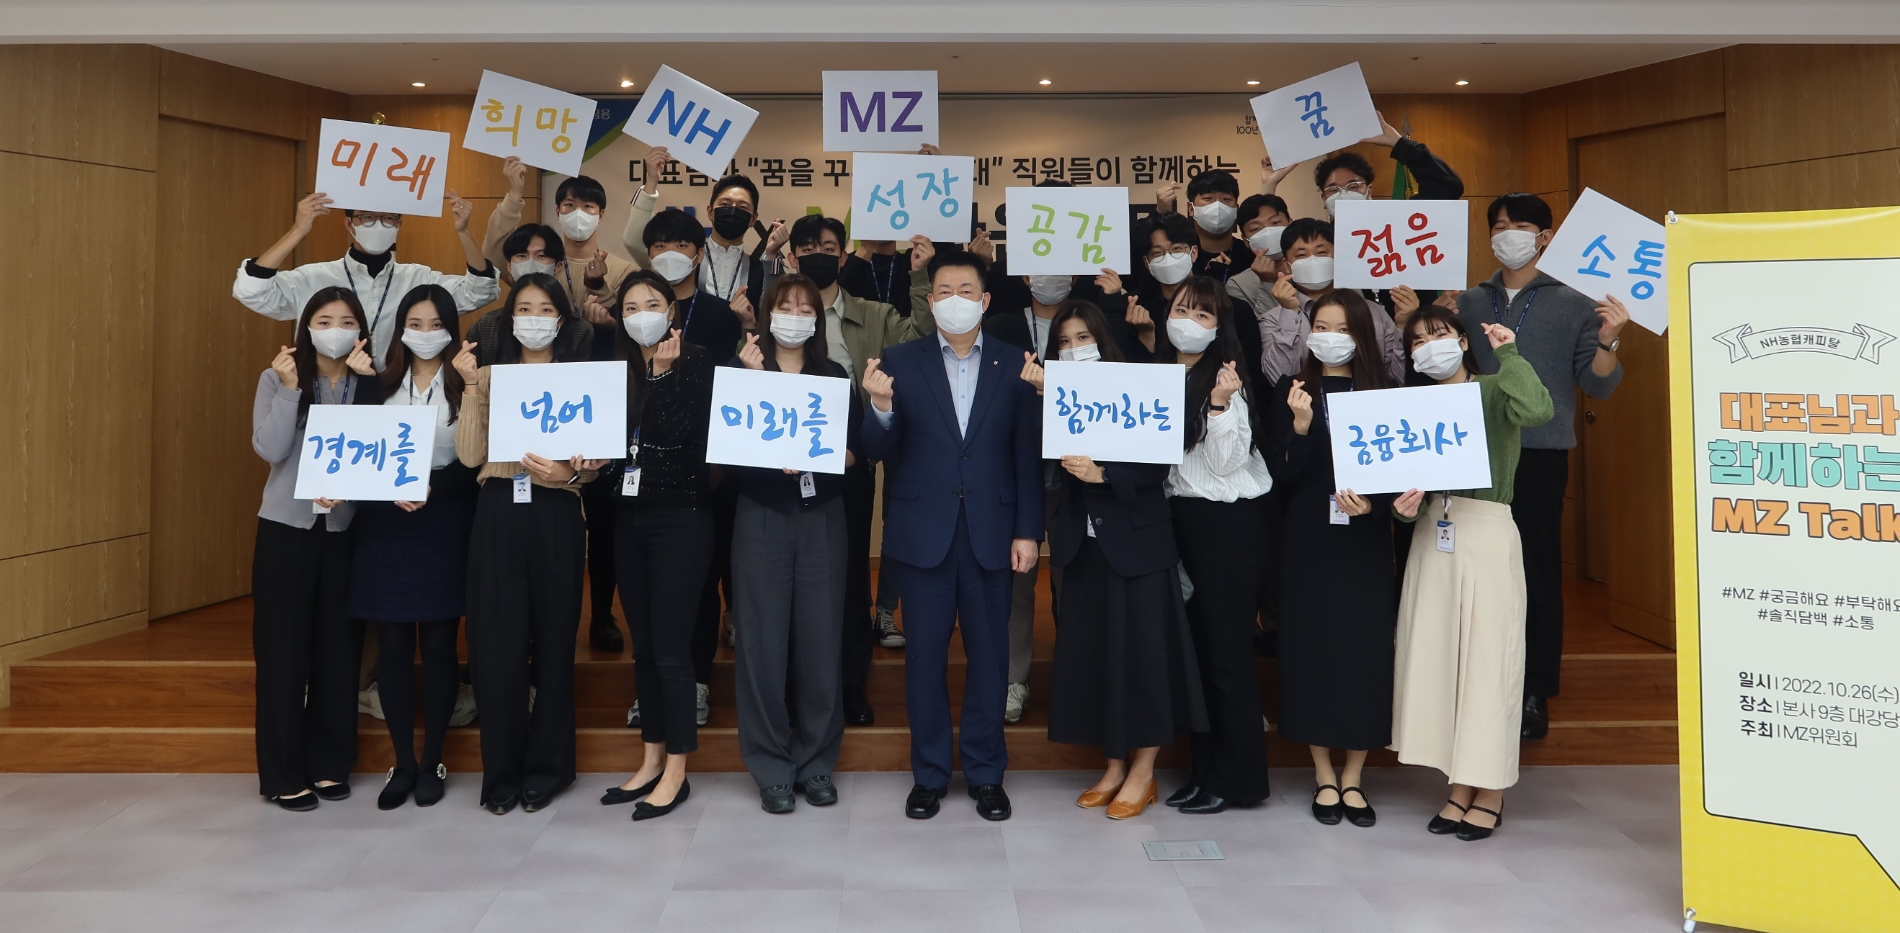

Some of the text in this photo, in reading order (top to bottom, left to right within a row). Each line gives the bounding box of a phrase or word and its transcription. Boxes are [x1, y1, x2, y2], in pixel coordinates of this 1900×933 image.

[480, 98, 577, 154] 희망
[647, 88, 732, 156] NH
[840, 91, 923, 132] MZ
[1294, 91, 1335, 139] 꿈
[331, 137, 435, 200] 미래
[1012, 156, 1121, 187] 직원들이
[867, 167, 959, 230] 성장
[1027, 204, 1112, 264] 공감
[1351, 212, 1445, 278] 젊음
[1577, 234, 1665, 300] 소통
[1760, 333, 1841, 349] NH농협캐피탈
[520, 391, 593, 434] 넘어
[721, 392, 834, 459] 미래를
[1055, 386, 1172, 435] 함께하는
[1719, 392, 1900, 436] 대표님과
[308, 422, 419, 487] 경계를
[1348, 418, 1468, 466] 금융회사
[1708, 439, 1900, 492] 함께하는
[1711, 497, 1900, 543] MZ Talk
[1721, 586, 1755, 601] #MZ
[1759, 589, 1829, 607] #궁금해요
[1757, 608, 1875, 631] #솔직담백 #소통
[1738, 671, 1900, 705] 일시 2022.10.26(수)
[1739, 694, 1773, 714] 장소
[1849, 707, 1900, 729] 대강당
[1740, 719, 1859, 748] 주최 MZ위원회
